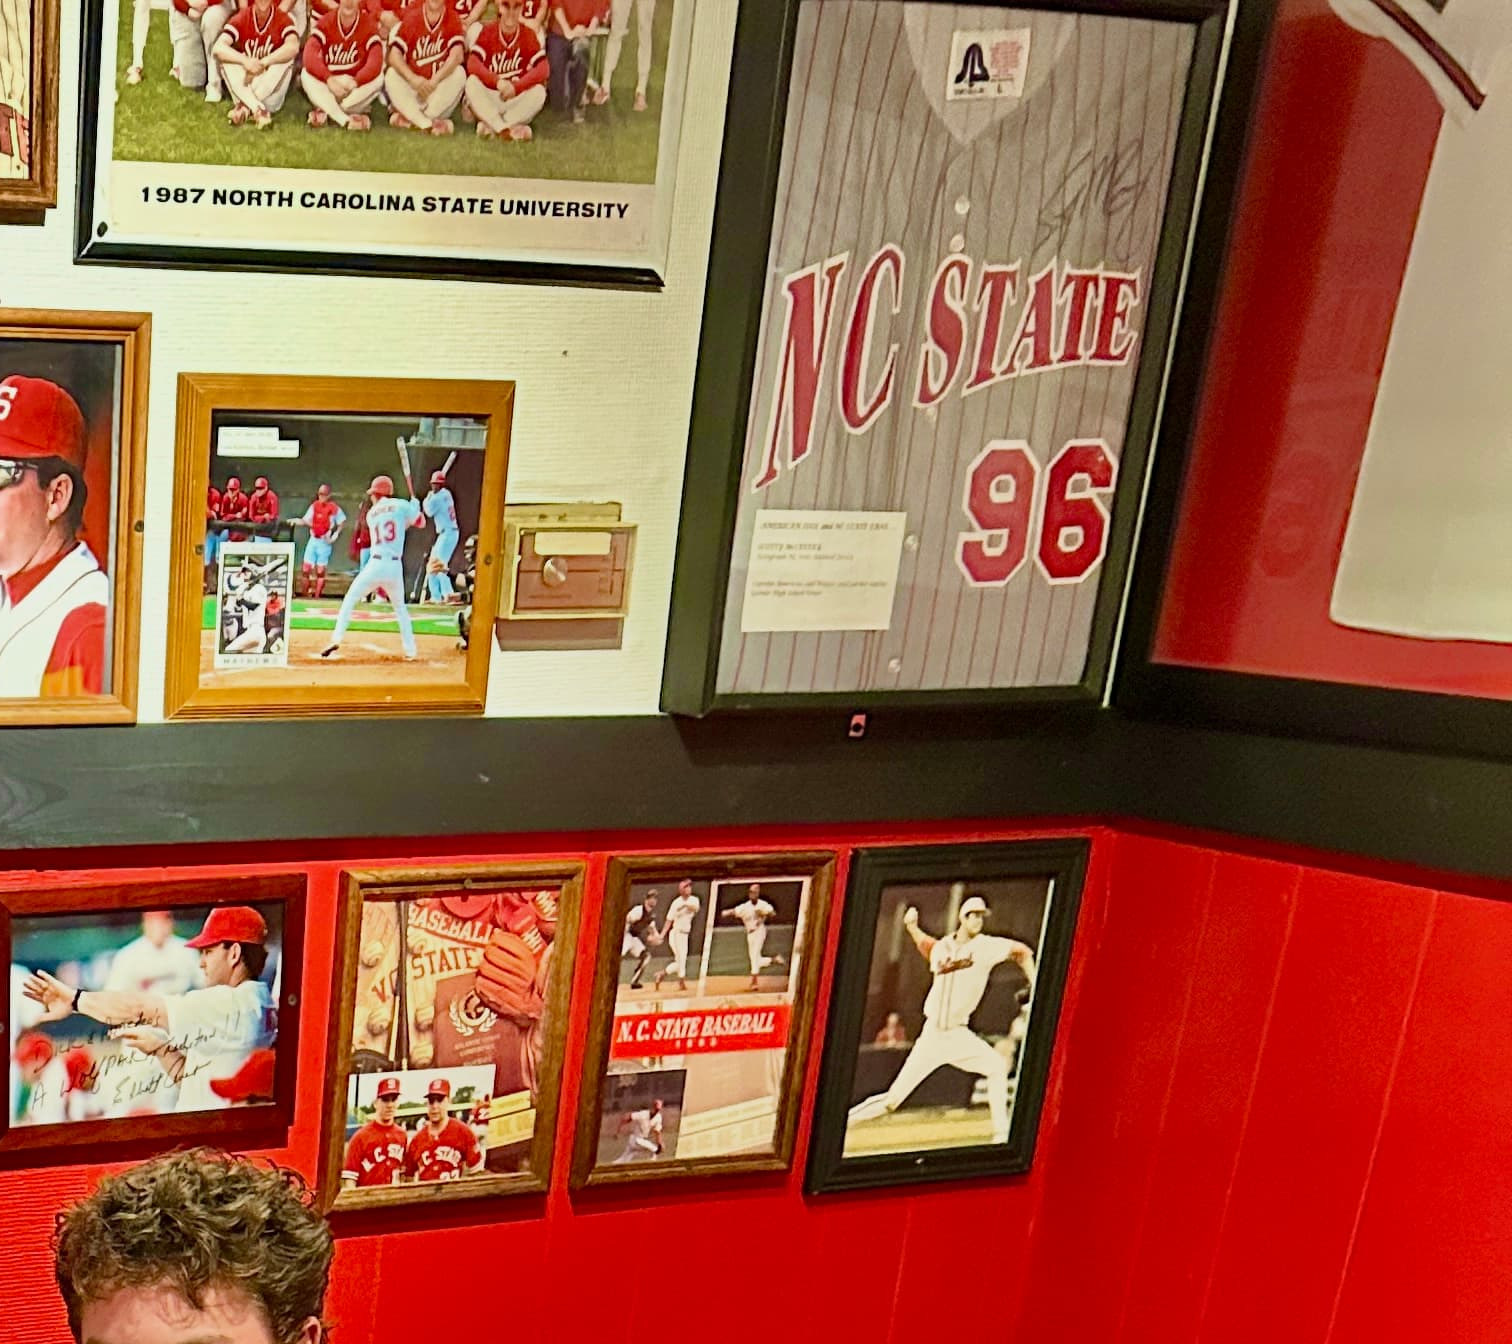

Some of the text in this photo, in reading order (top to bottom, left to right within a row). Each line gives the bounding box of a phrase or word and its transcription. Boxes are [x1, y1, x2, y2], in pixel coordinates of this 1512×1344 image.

[141, 186, 629, 219] 1987 NORTH CAROLINA STATE UNIVERSITY
[751, 243, 1141, 494] NC STATE
[955, 437, 1119, 588] 96
[374, 521, 396, 545] 13
[410, 947, 478, 980] STATE
[616, 1010, 776, 1044] N. C. STATE BASEBALL
